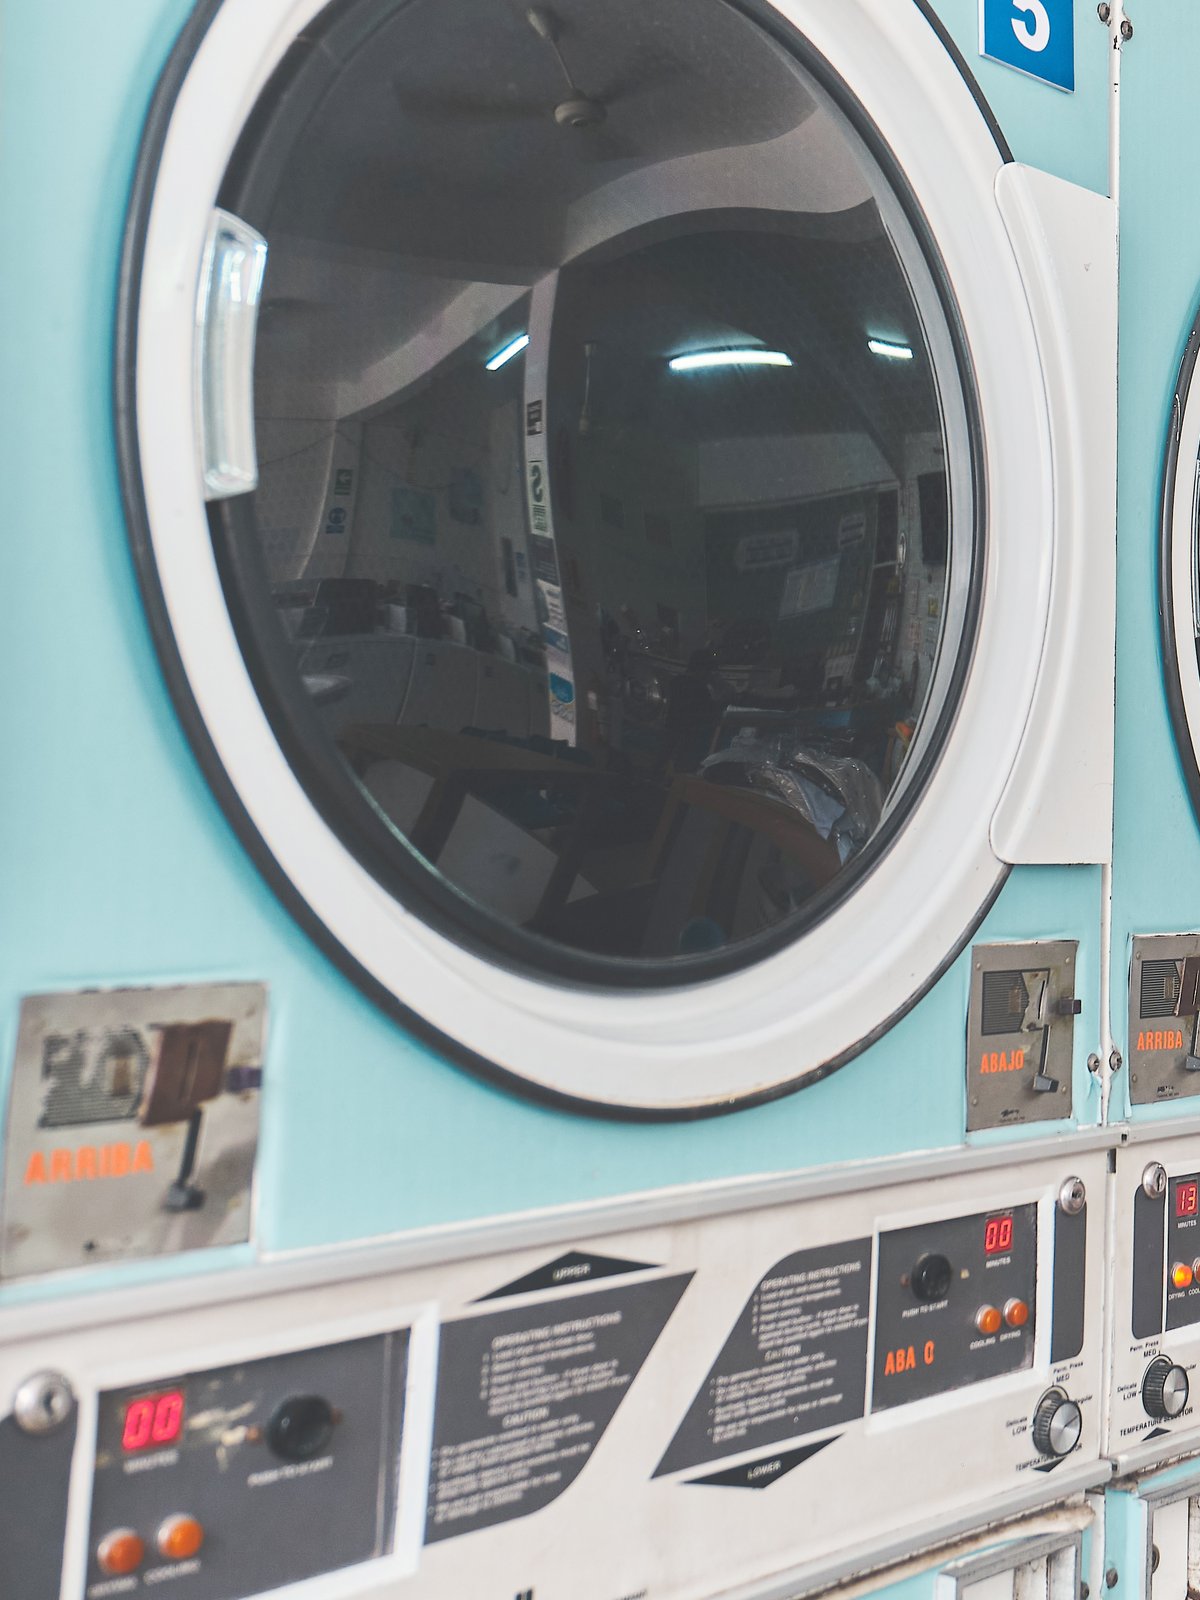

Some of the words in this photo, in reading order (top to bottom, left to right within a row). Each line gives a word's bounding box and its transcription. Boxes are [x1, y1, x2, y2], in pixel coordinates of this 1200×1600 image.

[1011, 0, 1050, 52] 5
[1137, 1030, 1183, 1050] ARRIBA
[980, 1049, 1024, 1074] ABAJO
[24, 1140, 154, 1186] ARRIBA
[1181, 1187, 1196, 1211] 13
[1178, 1220, 1197, 1229] MINUTES
[986, 1220, 1012, 1250] 00
[986, 1256, 1011, 1268] MINUTES
[1168, 1291, 1186, 1300] DRYING
[885, 1346, 916, 1376] ABA
[1144, 1350, 1156, 1358] MED
[1056, 1374, 1070, 1382] MED
[1118, 1383, 1137, 1392] Delicate
[1123, 1392, 1136, 1400] LOW
[122, 1391, 184, 1451] 00
[1012, 1426, 1027, 1436] LOW
